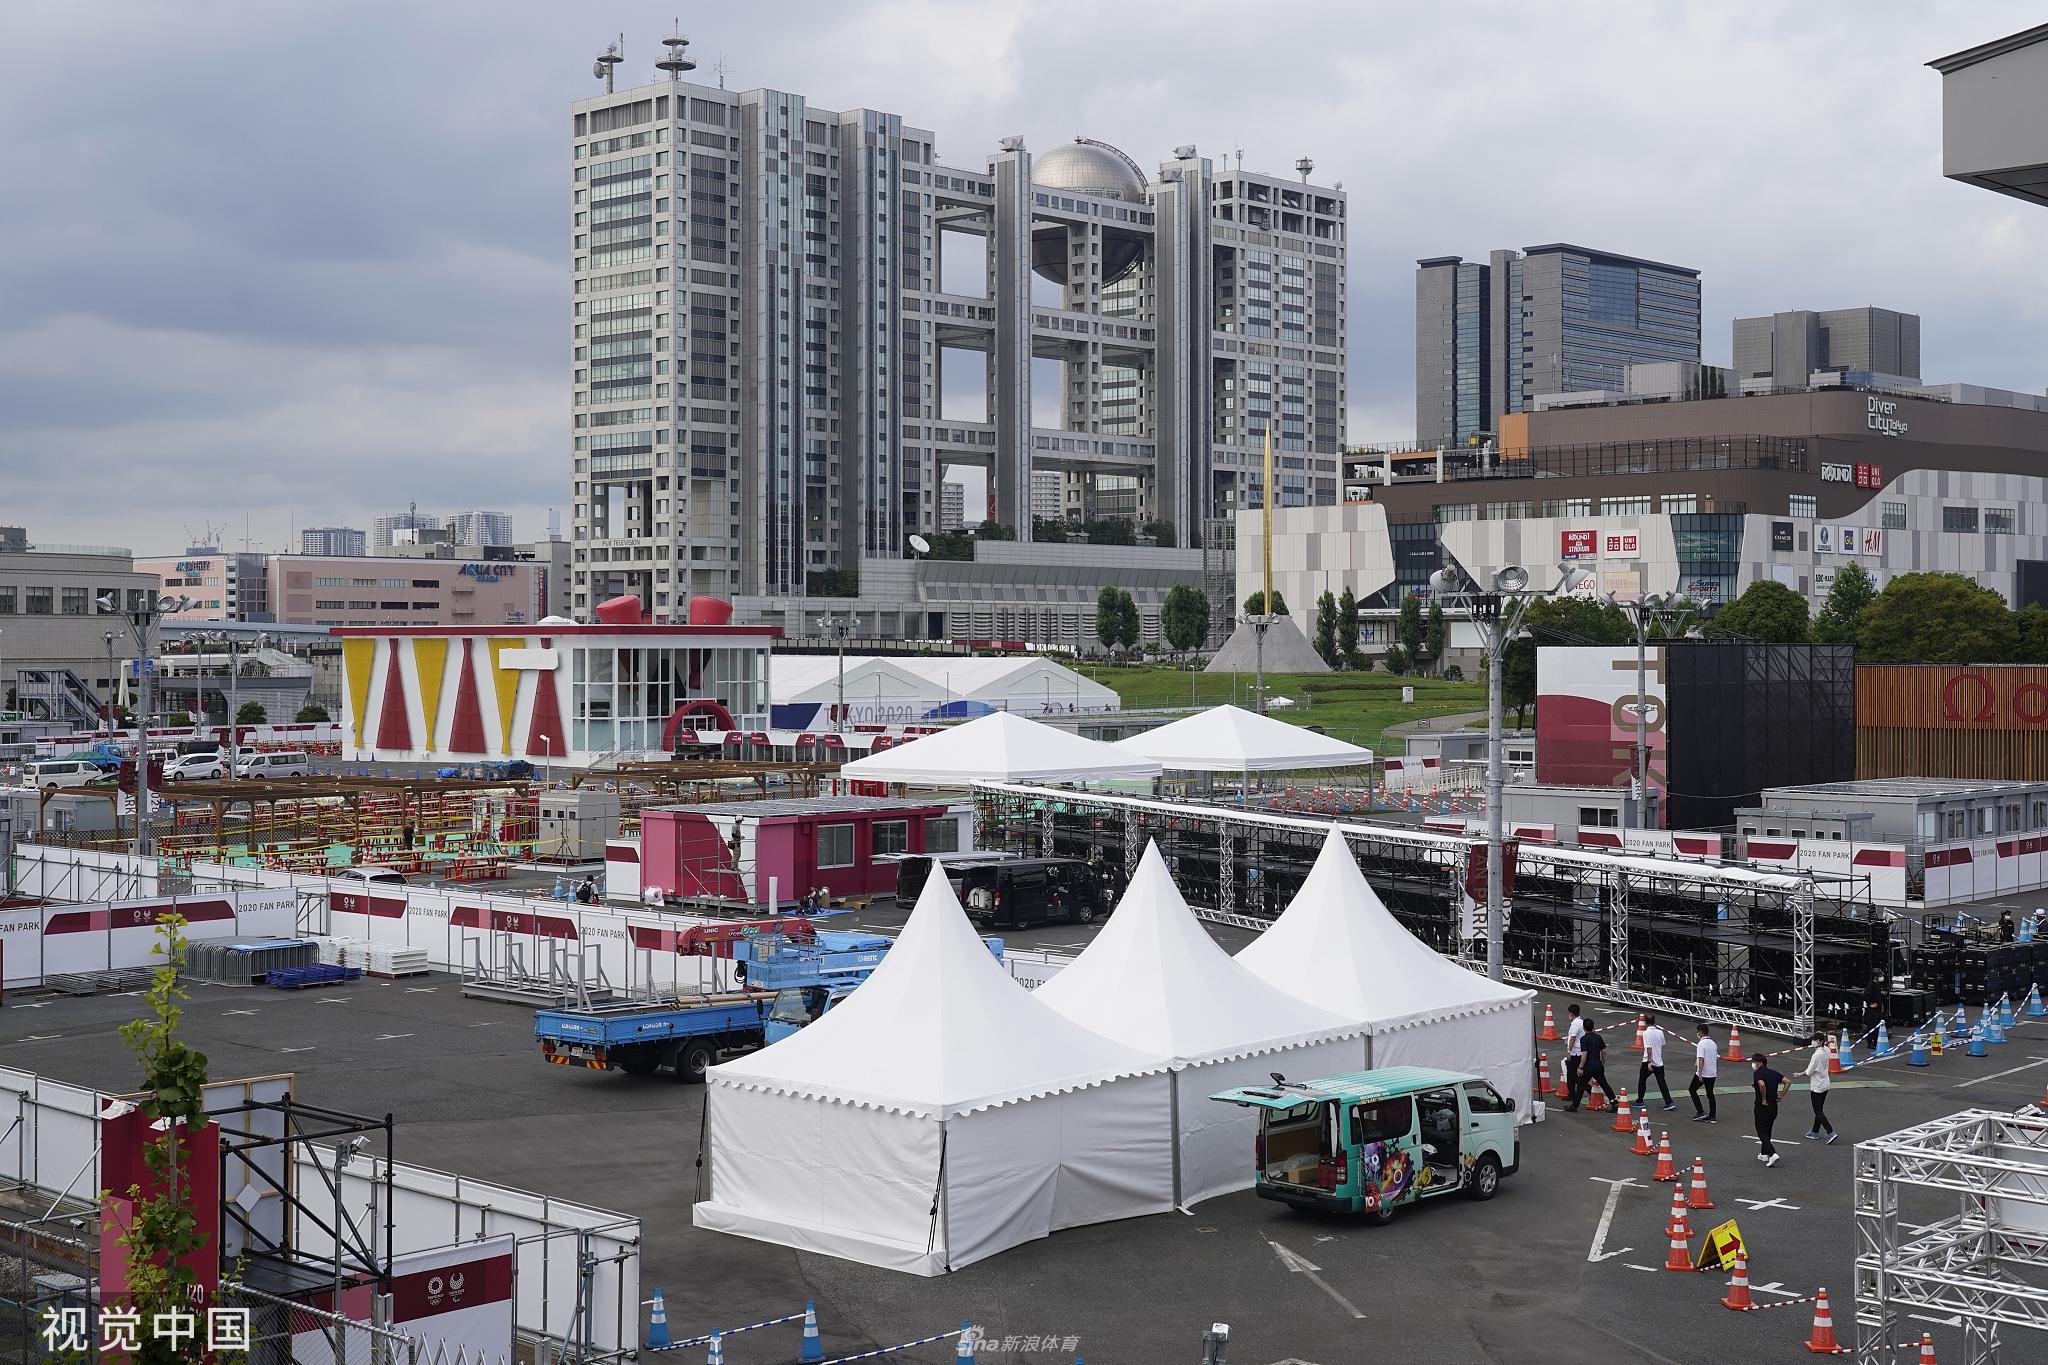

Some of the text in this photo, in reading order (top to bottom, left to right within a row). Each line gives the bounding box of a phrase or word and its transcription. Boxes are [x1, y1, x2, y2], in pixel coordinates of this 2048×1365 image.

[1868, 396, 1896, 415] Diver
[1868, 412, 1889, 436] City
[493, 564, 517, 577] CITY
[1575, 579, 1595, 590] EGO
[824, 707, 873, 726] TKYO
[1625, 838, 1671, 849] 2020 FAN PARK
[1800, 849, 1850, 860] 2020 FAN PARK
[238, 900, 296, 913] 2020 FAN PARK
[423, 908, 434, 917] FAN
[17, 921, 40, 932] PARK
[597, 928, 609, 938] FAN
[609, 929, 625, 940] PARK
